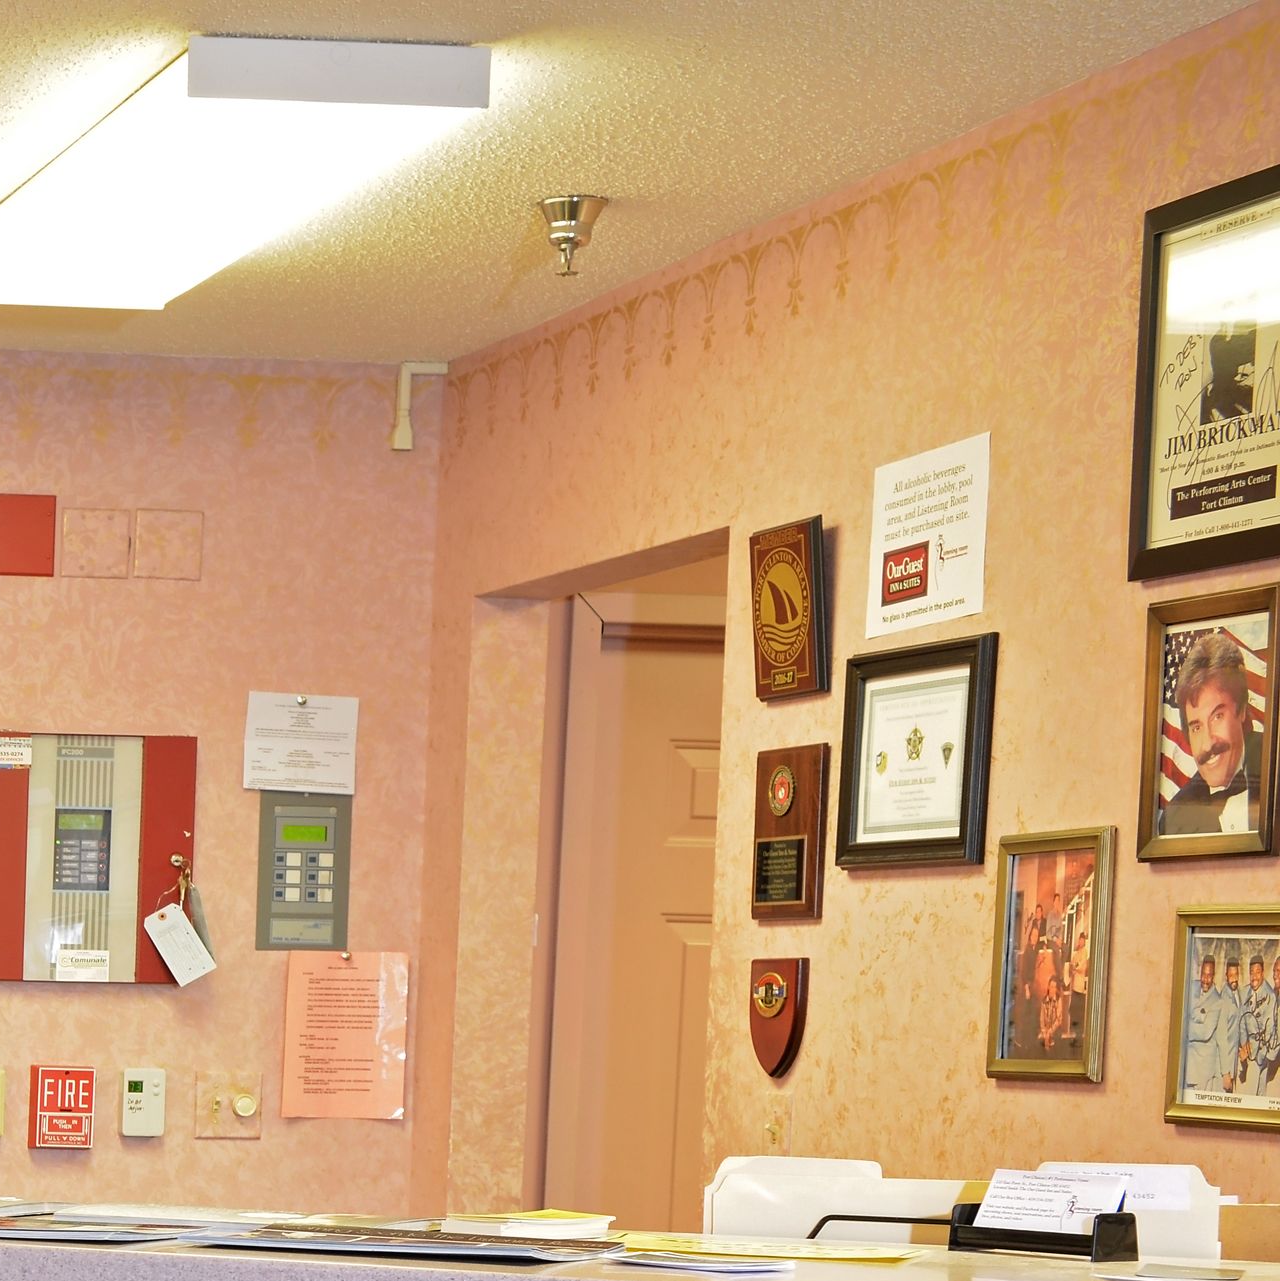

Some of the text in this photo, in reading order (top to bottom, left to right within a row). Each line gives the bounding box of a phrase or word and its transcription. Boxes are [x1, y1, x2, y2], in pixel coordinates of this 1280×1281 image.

[1164, 432, 1193, 460] JIM
[893, 463, 966, 494] All alcoholic beverages
[1176, 473, 1272, 502] The Performing Arts Center
[884, 491, 917, 512] consumed
[917, 493, 924, 502] in
[925, 487, 936, 499] the
[958, 473, 974, 492] pool
[1218, 494, 1244, 508] Clinton
[903, 508, 917, 521] and
[917, 500, 949, 517] Listening
[950, 494, 969, 508] Room
[759, 527, 798, 550] MEMBER
[884, 531, 901, 542] must
[902, 526, 910, 537] be
[910, 515, 945, 537] purchased
[945, 515, 954, 524] on
[754, 550, 806, 602] PORT CLINTON AREA
[886, 557, 924, 580] OurGuest
[889, 576, 921, 593] INN SUITES
[905, 606, 929, 619] permitted
[934, 603, 943, 611] the
[943, 600, 955, 610] pool
[754, 599, 810, 663] CHAMBER OF COMMERCE
[774, 671, 794, 685] 2016-17
[70, 956, 107, 964] Comunale
[43, 1078, 90, 1109] FIRE
[1194, 1093, 1243, 1104] TEMPTATION REVIEW
